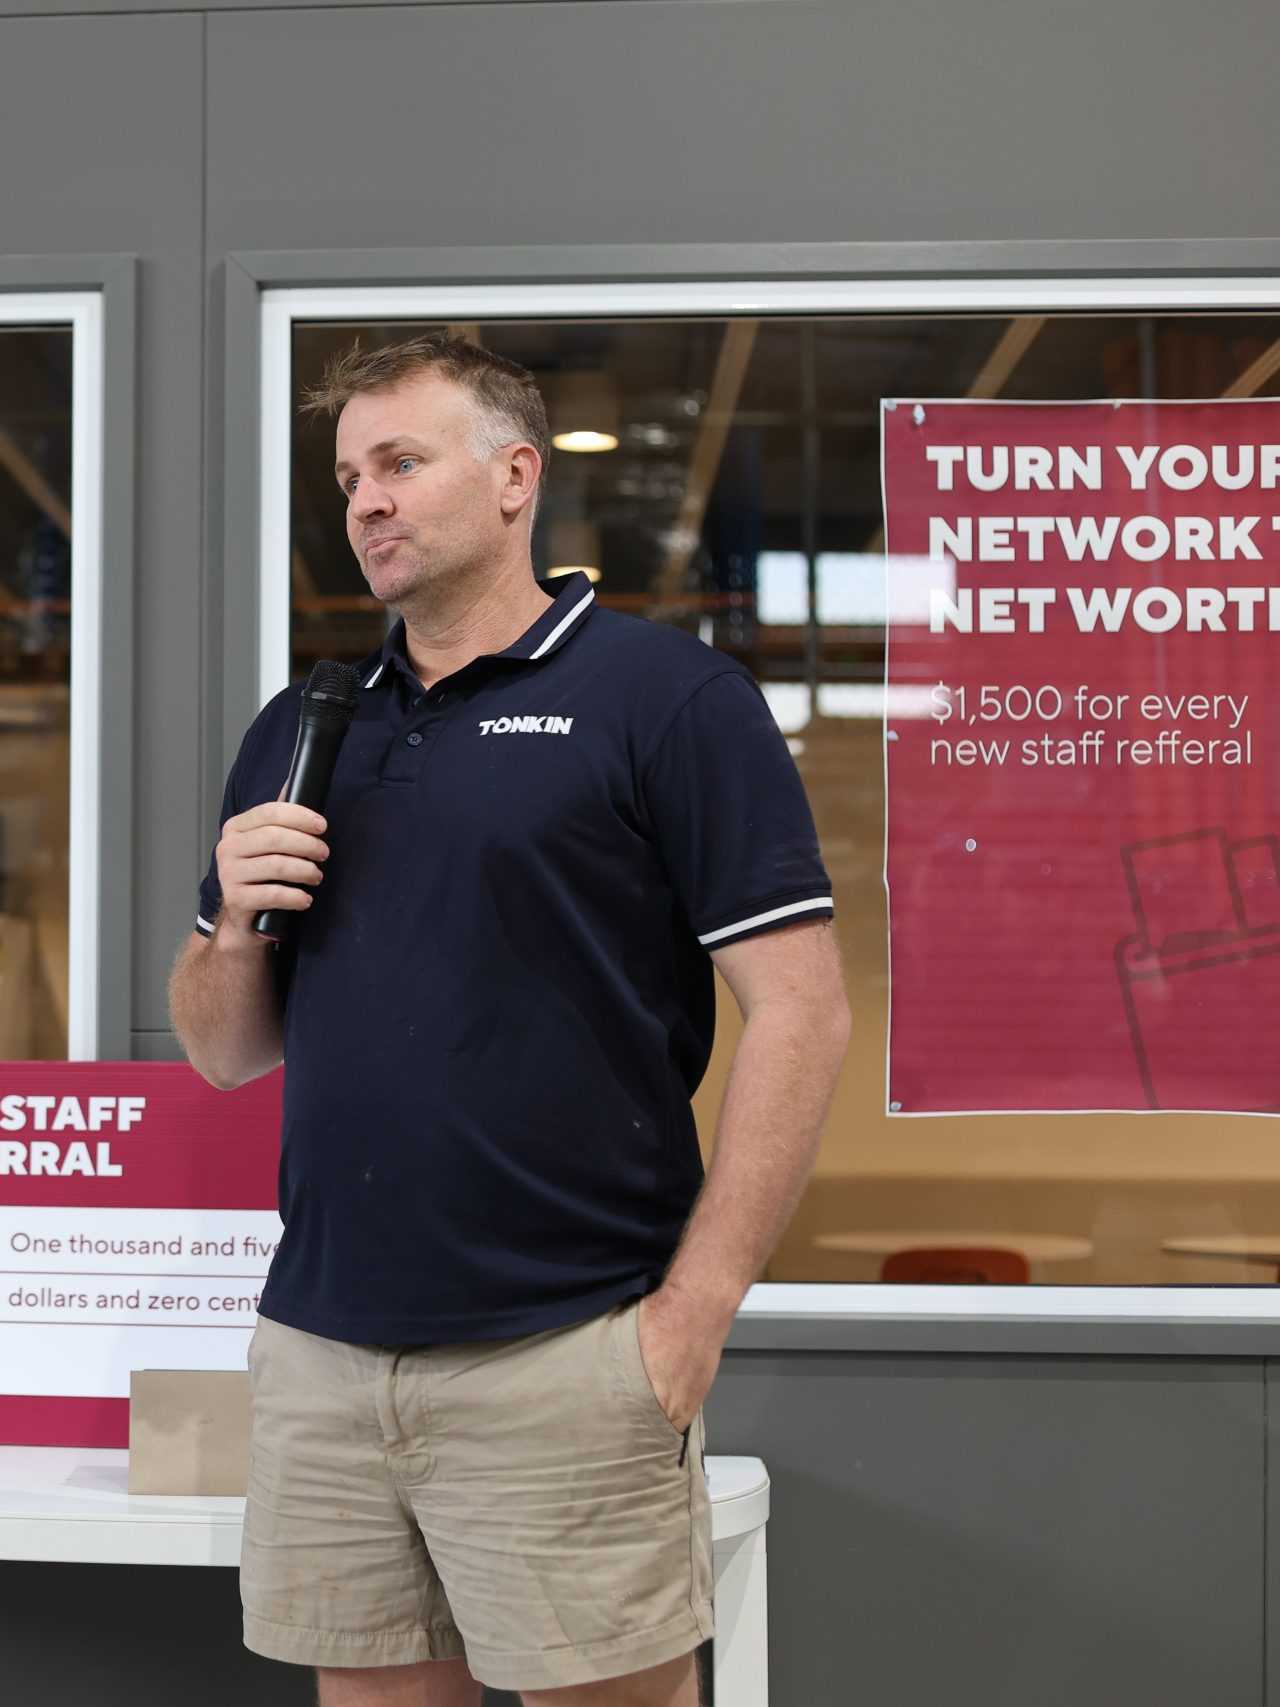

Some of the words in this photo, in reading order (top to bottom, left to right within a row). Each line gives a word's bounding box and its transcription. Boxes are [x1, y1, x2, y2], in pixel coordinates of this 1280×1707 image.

[927, 445, 1102, 491] TURN
[929, 516, 1263, 562] NETWORK
[929, 587, 1056, 633] NET
[1066, 586, 1280, 633] WORT
[930, 681, 1063, 726] $1,500
[1074, 685, 1129, 720] for
[1140, 694, 1248, 728] every
[478, 715, 574, 736] TONKIN
[931, 739, 1010, 765] new
[1021, 731, 1105, 765] staff
[1117, 731, 1252, 765] refferal
[10, 1232, 62, 1253] One
[69, 1233, 183, 1256] thousand
[190, 1236, 235, 1257] and
[8, 1287, 89, 1309] dollars
[96, 1289, 141, 1310] and
[148, 1294, 201, 1311] zero
